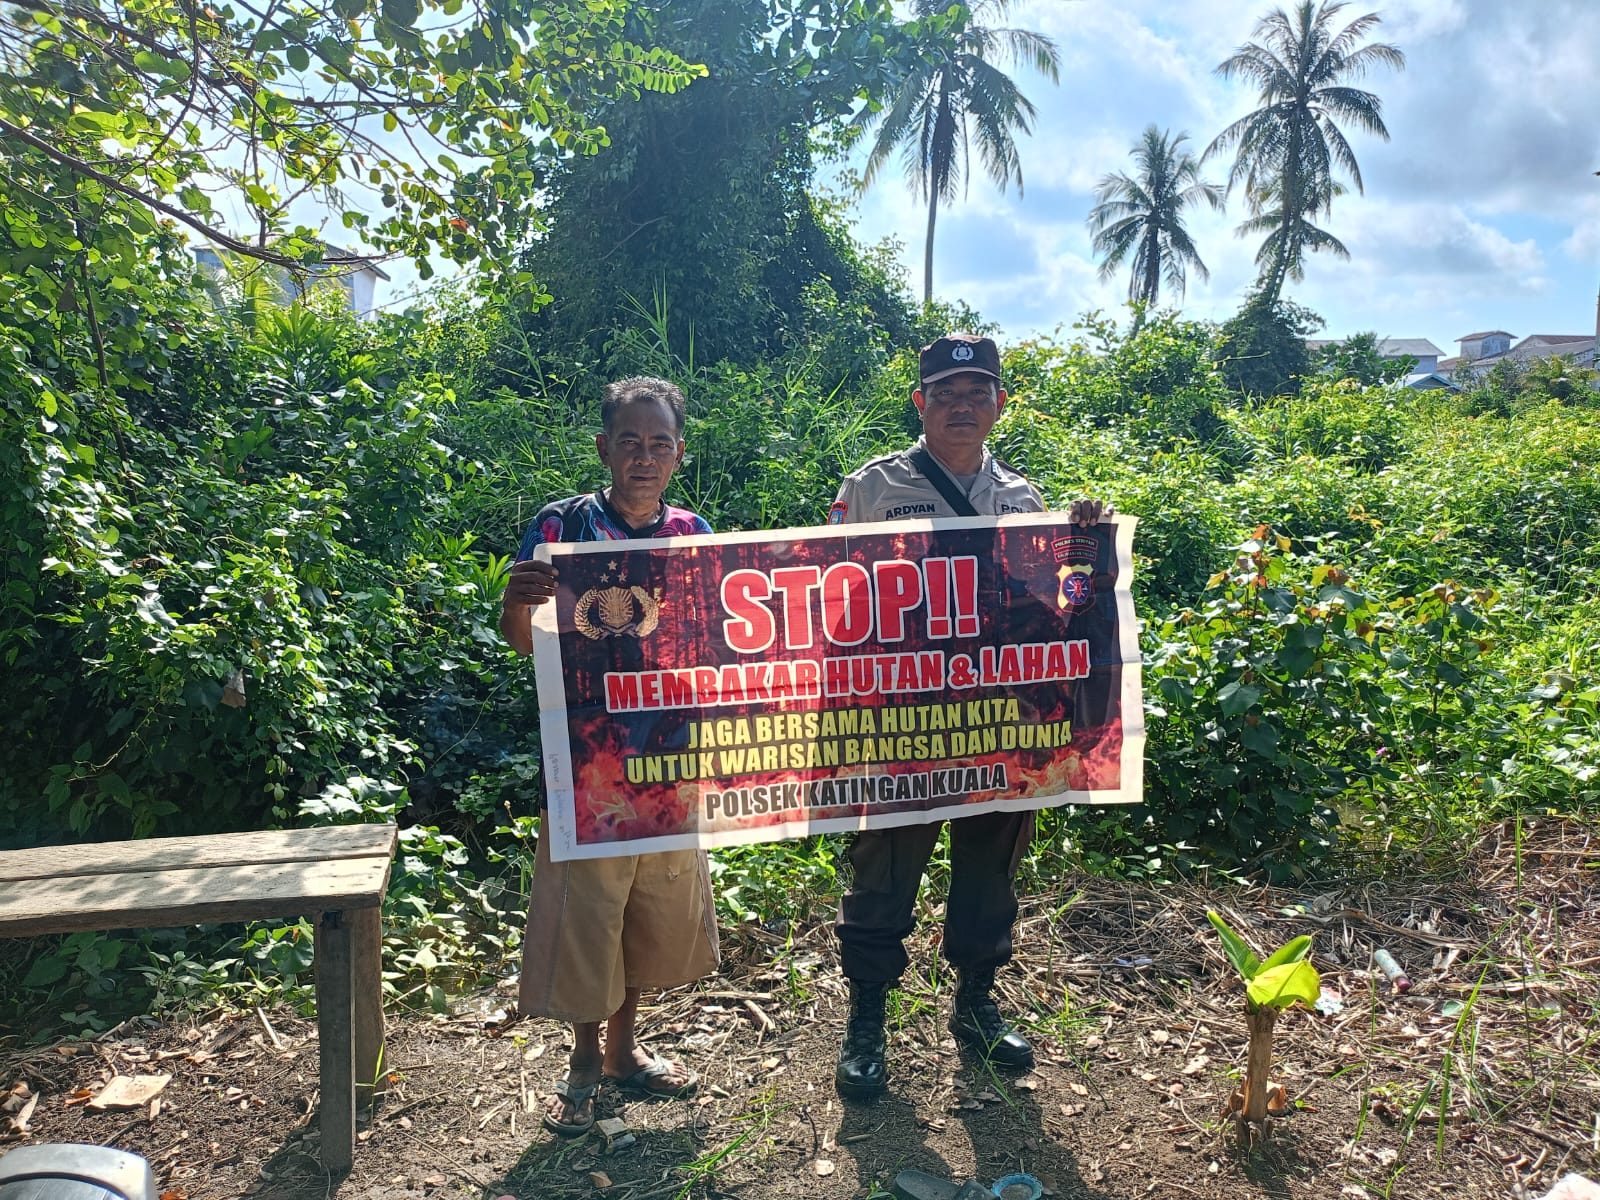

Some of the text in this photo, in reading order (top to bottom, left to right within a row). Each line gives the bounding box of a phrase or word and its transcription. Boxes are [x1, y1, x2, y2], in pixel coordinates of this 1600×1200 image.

[885, 503, 936, 521] ARDYAN
[721, 555, 980, 654] STOP!!
[604, 639, 1091, 713] MEMBAKAR HUTAN & LAHAN
[626, 720, 1072, 783] UNTUK WARISAN BANGSA DAN DUNIA
[688, 698, 1020, 749] JAGA BERSAMA HUTAN KITA
[705, 763, 1009, 821] POLSEK KATINGAN KUALA
